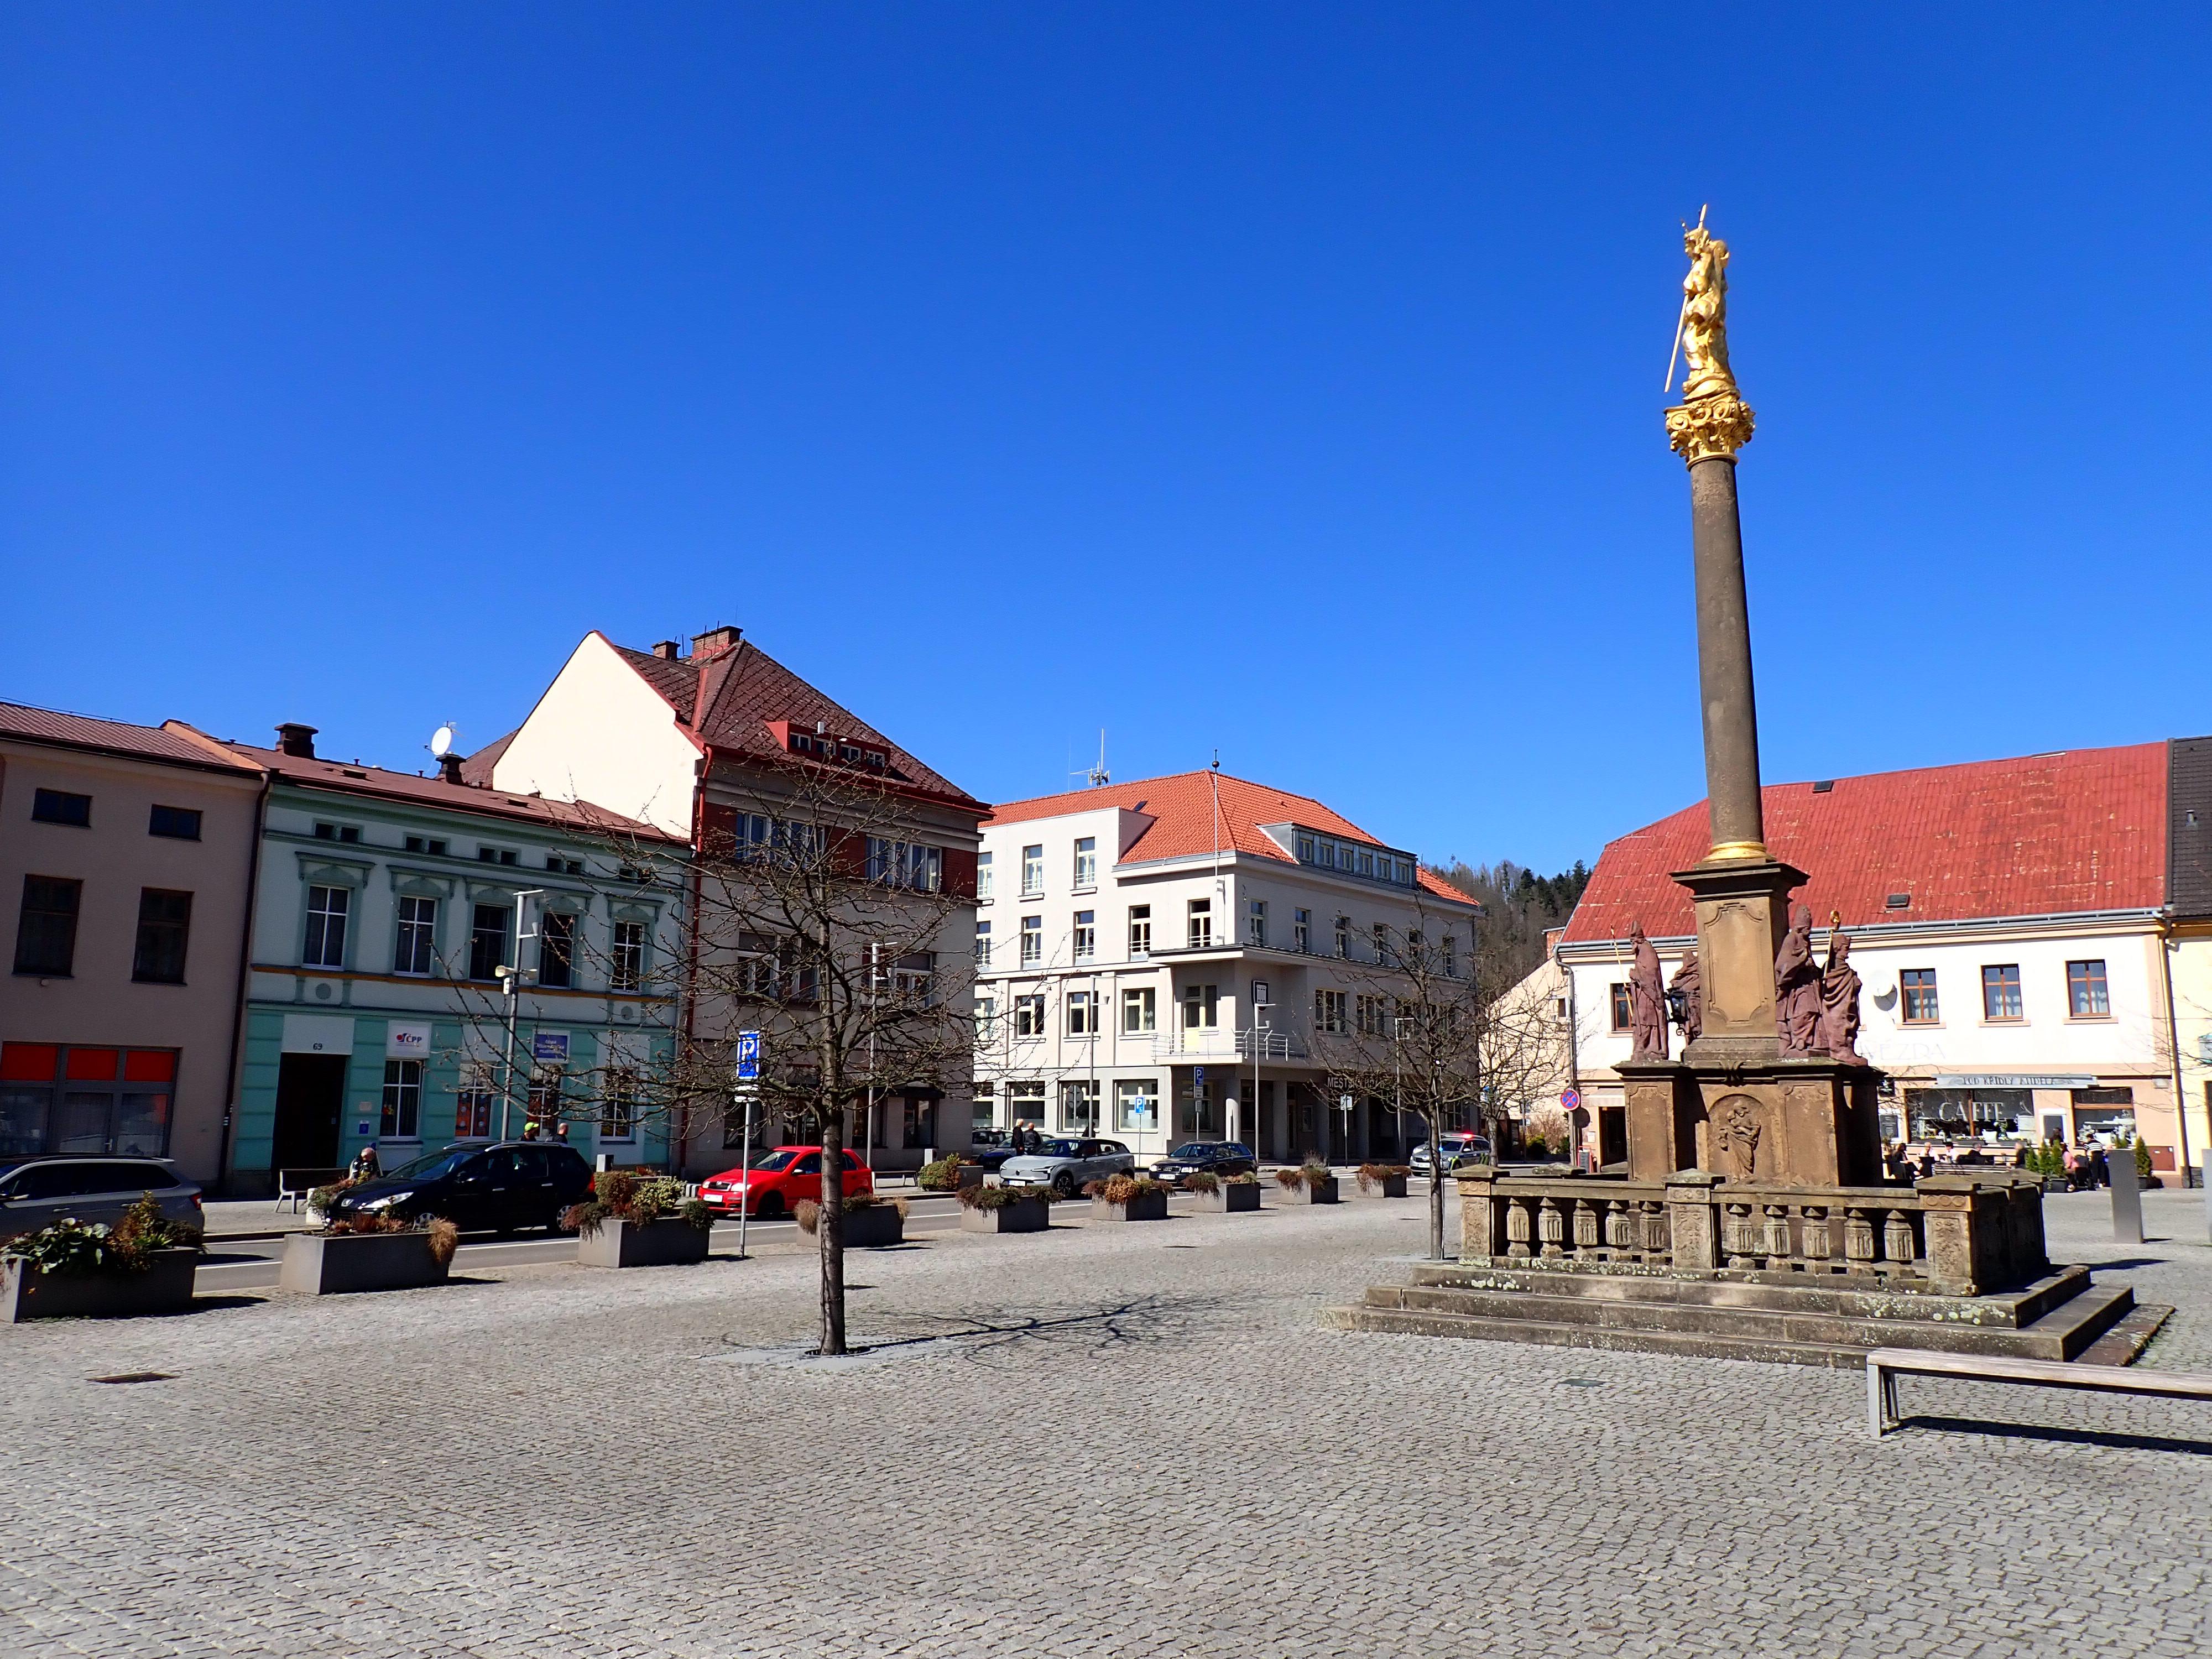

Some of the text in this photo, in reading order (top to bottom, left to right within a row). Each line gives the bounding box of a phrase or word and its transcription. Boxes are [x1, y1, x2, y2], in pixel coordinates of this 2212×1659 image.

[406, 1034, 422, 1043] ČPP
[1197, 1069, 1202, 1080] P
[1136, 1098, 1142, 1109] P
